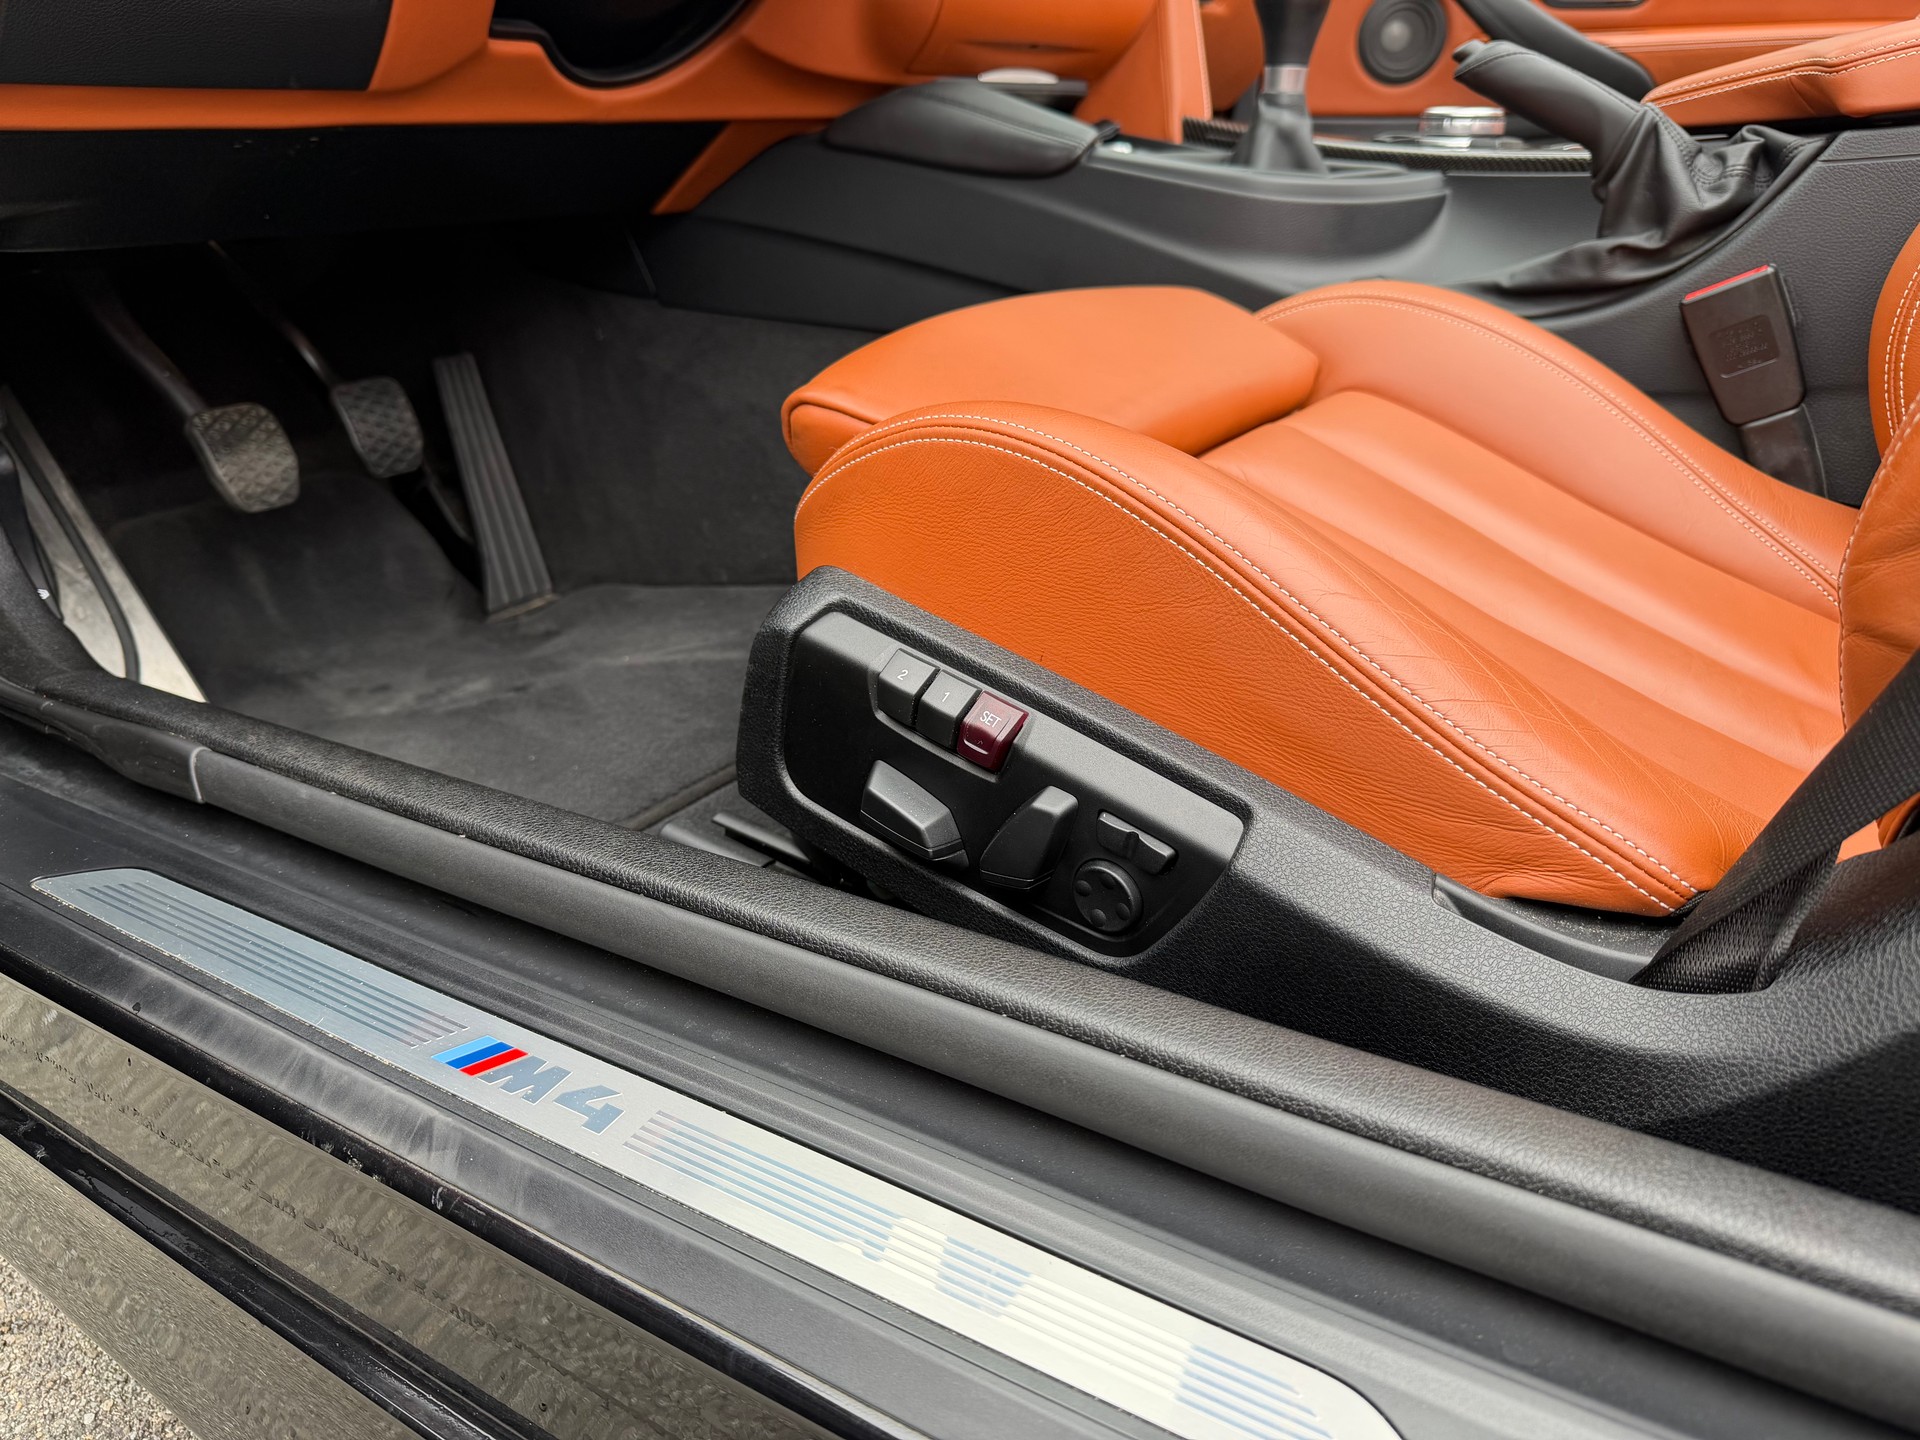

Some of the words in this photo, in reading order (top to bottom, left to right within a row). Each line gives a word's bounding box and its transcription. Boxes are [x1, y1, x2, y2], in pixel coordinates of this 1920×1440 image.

[897, 669, 908, 681] 2
[941, 691, 950, 703] 1
[979, 710, 1002, 728] SET
[477, 1055, 626, 1135] M4
